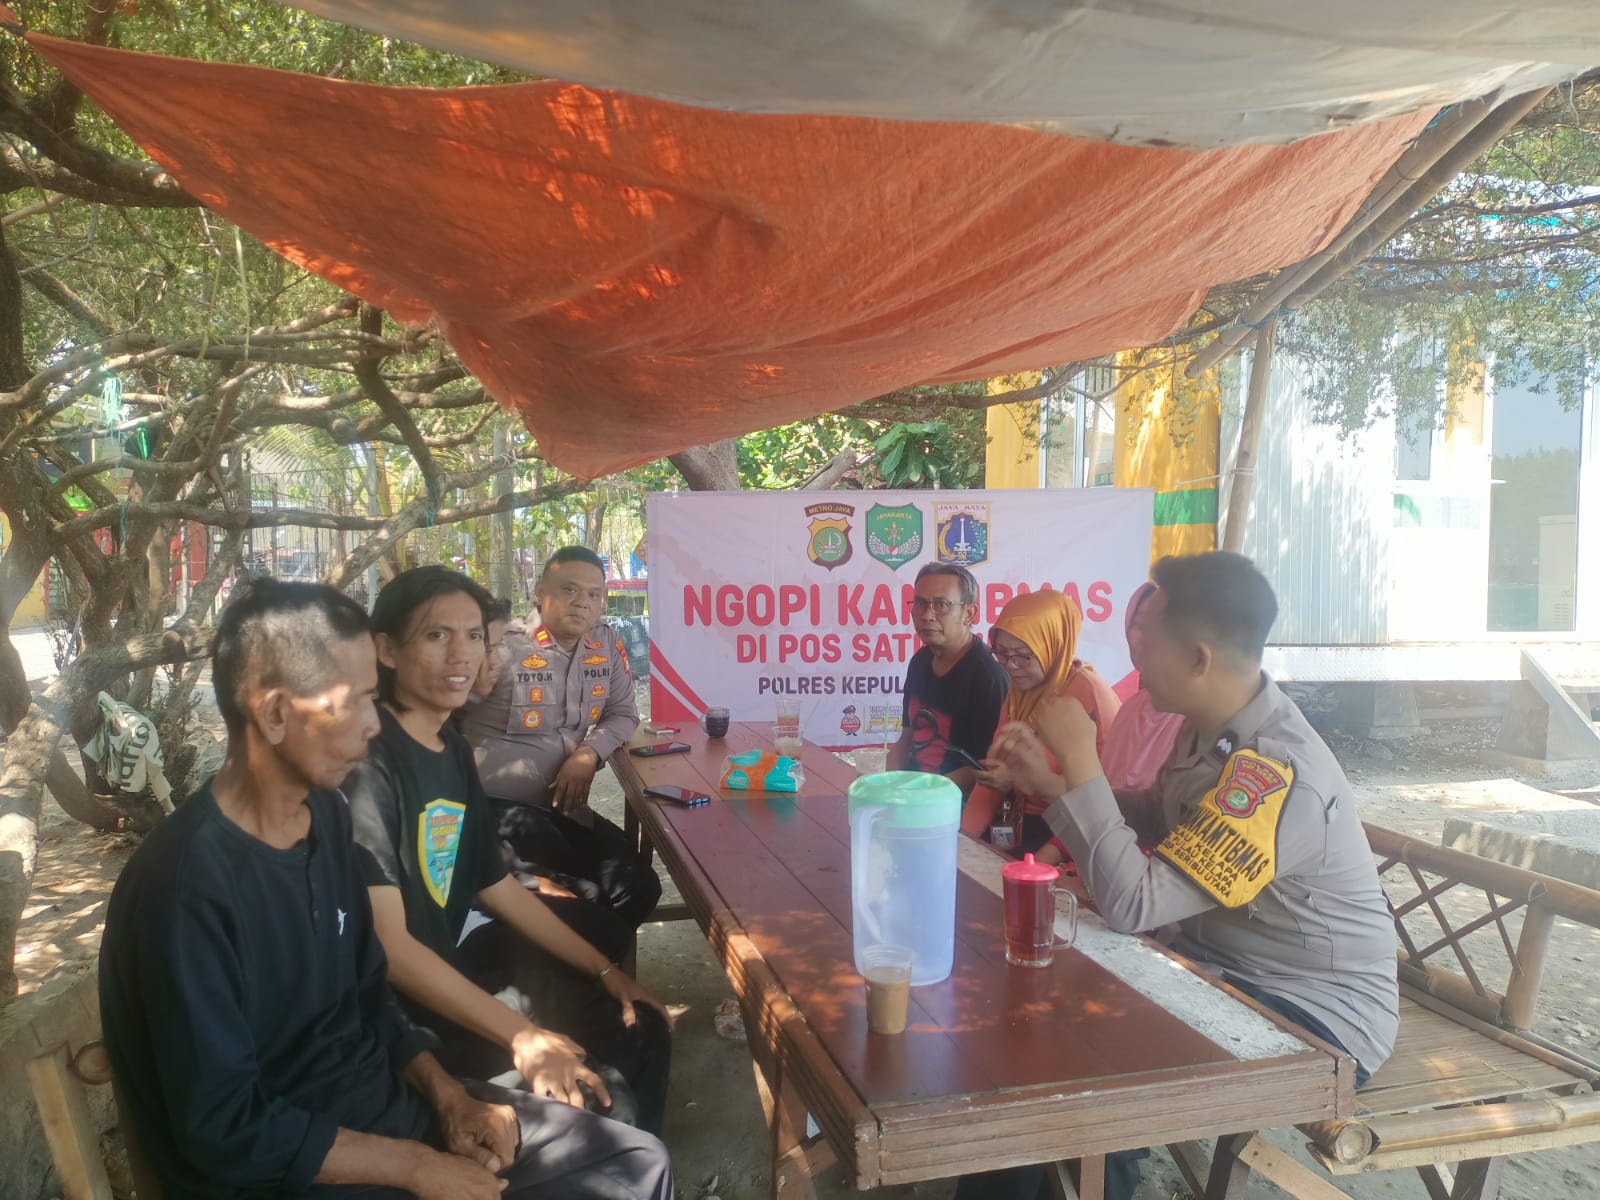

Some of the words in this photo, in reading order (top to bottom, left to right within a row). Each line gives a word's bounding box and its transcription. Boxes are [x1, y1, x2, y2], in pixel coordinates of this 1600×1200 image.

[808, 503, 833, 515] METRO
[832, 504, 852, 515] JAYA
[876, 511, 913, 522] JAYAKARTA
[938, 504, 959, 512] JAYA
[683, 583, 821, 627] NGOPI
[736, 633, 767, 664] DI
[778, 633, 842, 664] POS
[583, 667, 610, 679] POLRI
[758, 675, 836, 695] POLRES
[841, 675, 905, 695] KEPUL
[1194, 841, 1238, 882] KELAPA
[1198, 856, 1233, 889] KELAPA
[1203, 873, 1232, 899] UTARA
